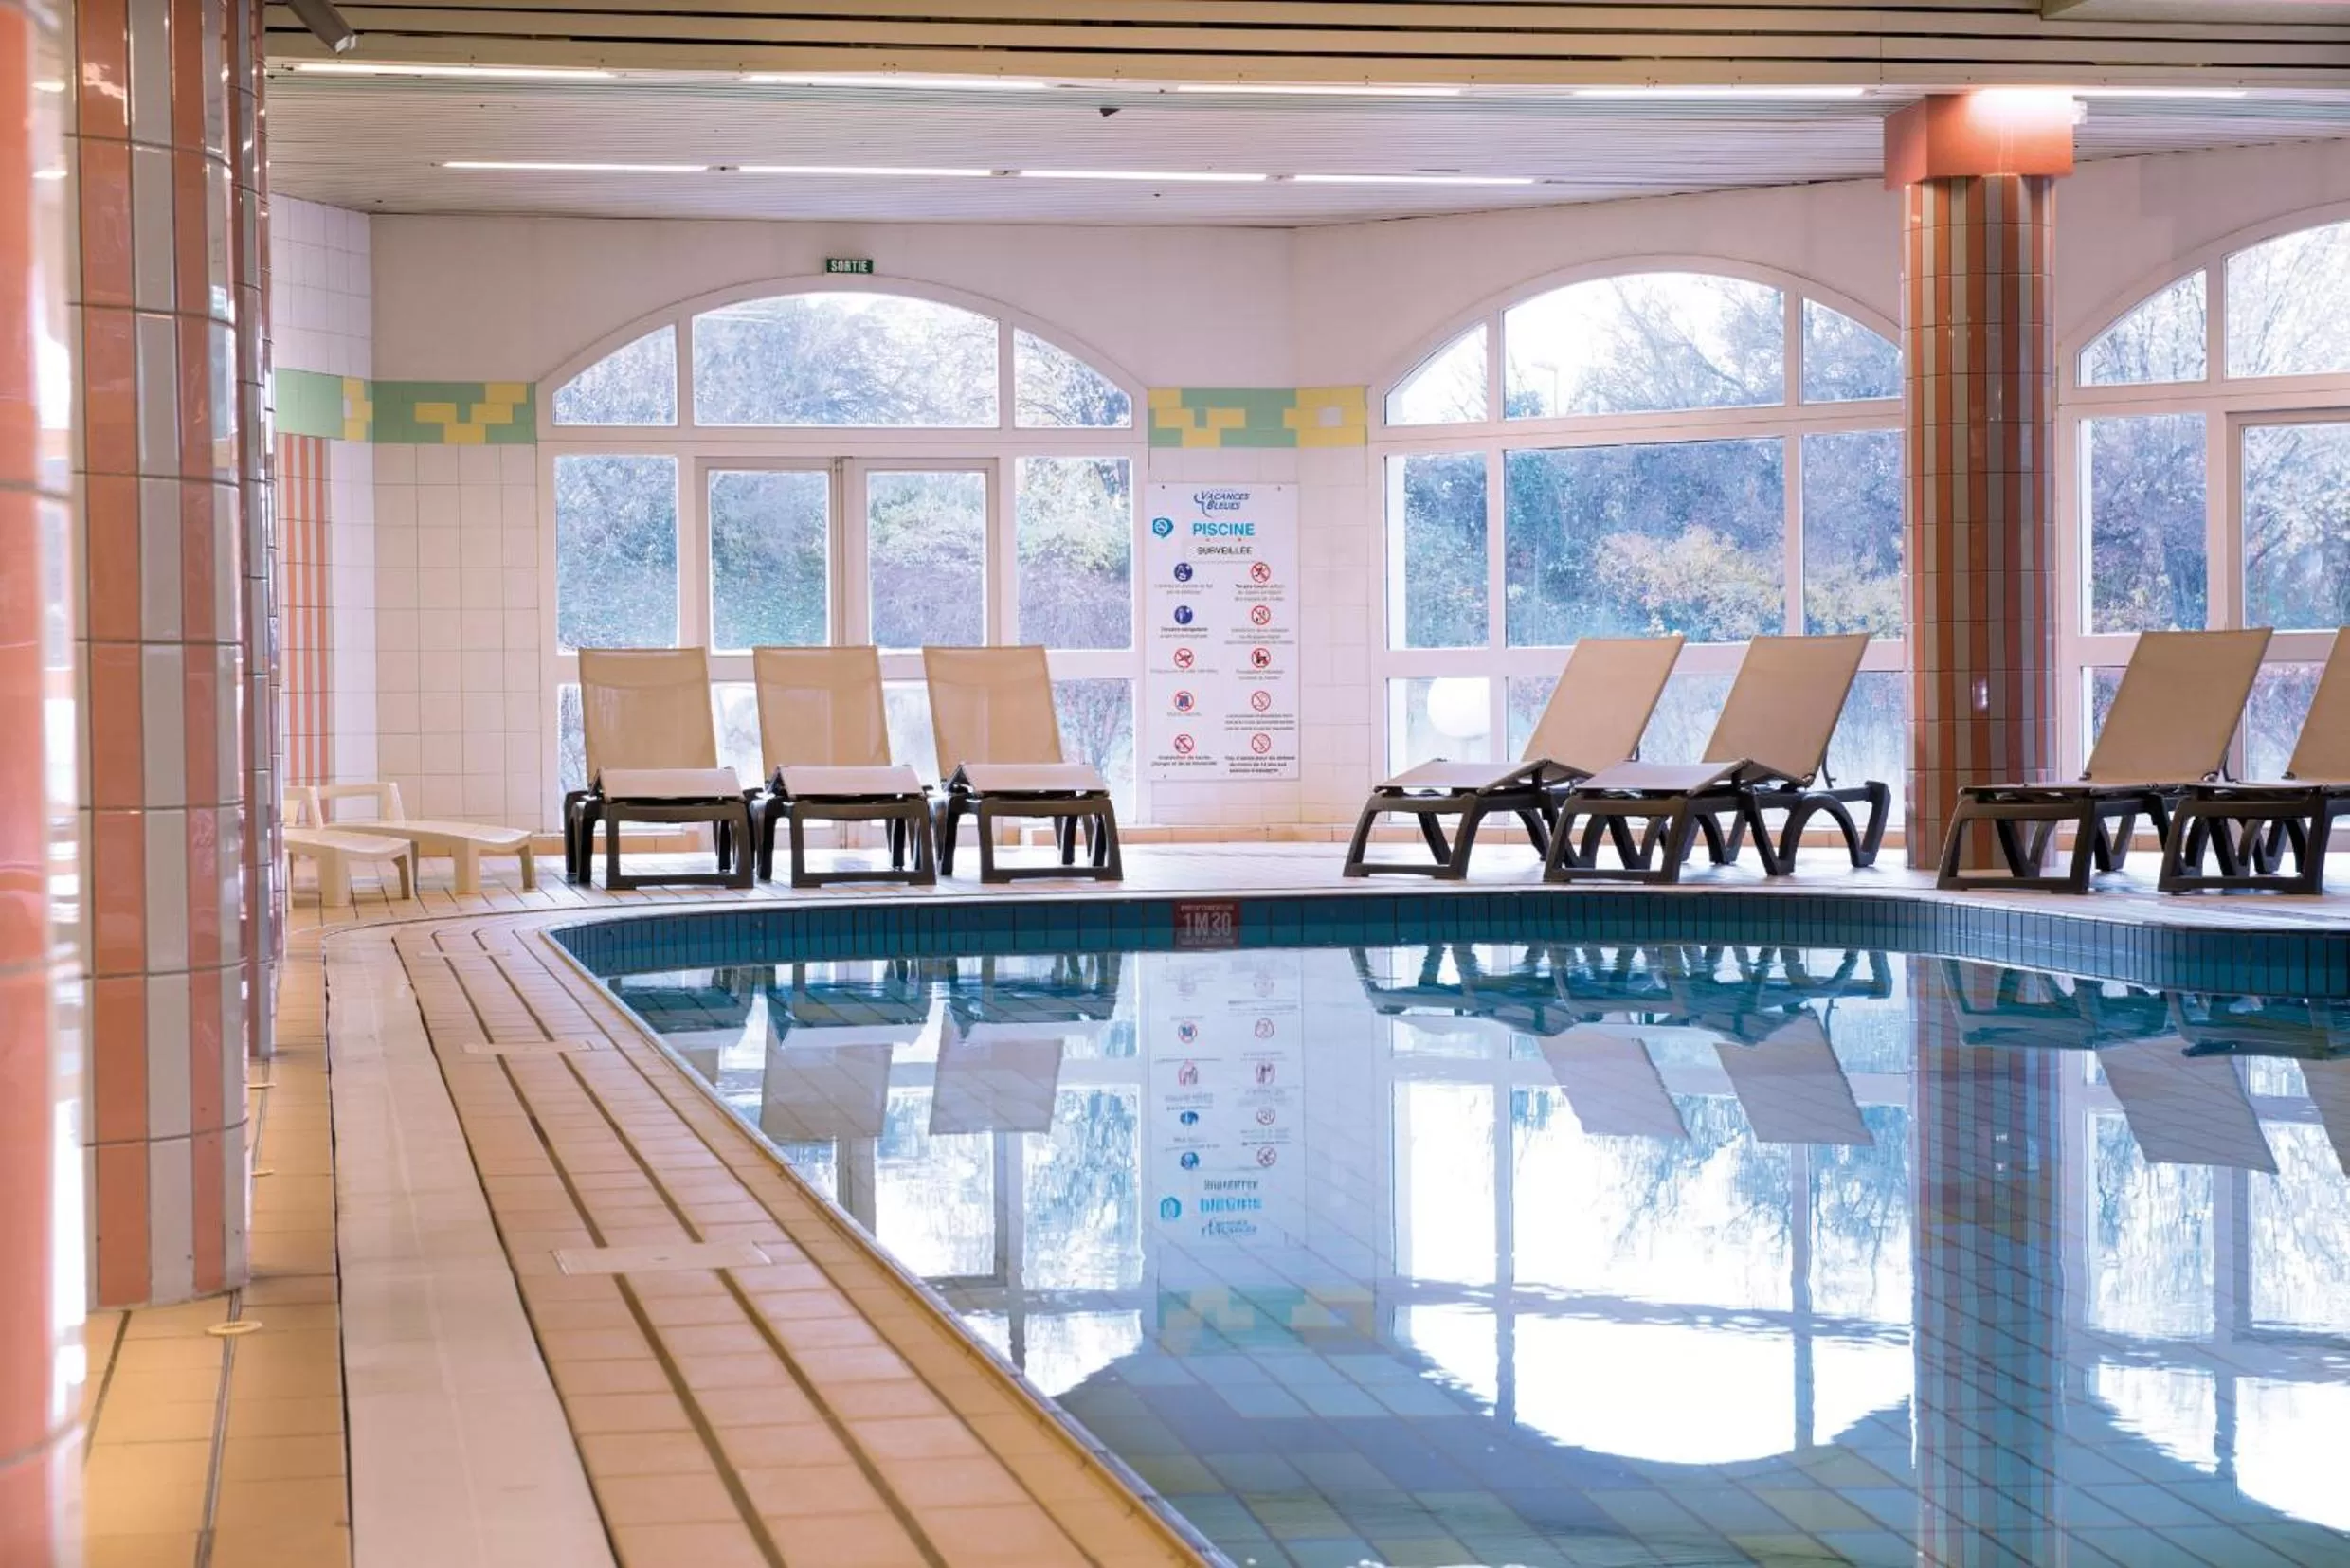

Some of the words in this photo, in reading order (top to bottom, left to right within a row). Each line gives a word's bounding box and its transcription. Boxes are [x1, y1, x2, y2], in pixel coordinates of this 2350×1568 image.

[831, 260, 868, 272] SORTIE
[1201, 490, 1251, 501] VACANCES
[1207, 500, 1241, 511] BLEUES
[1193, 522, 1256, 537] PISCINE
[1184, 911, 1232, 937] 1M30
